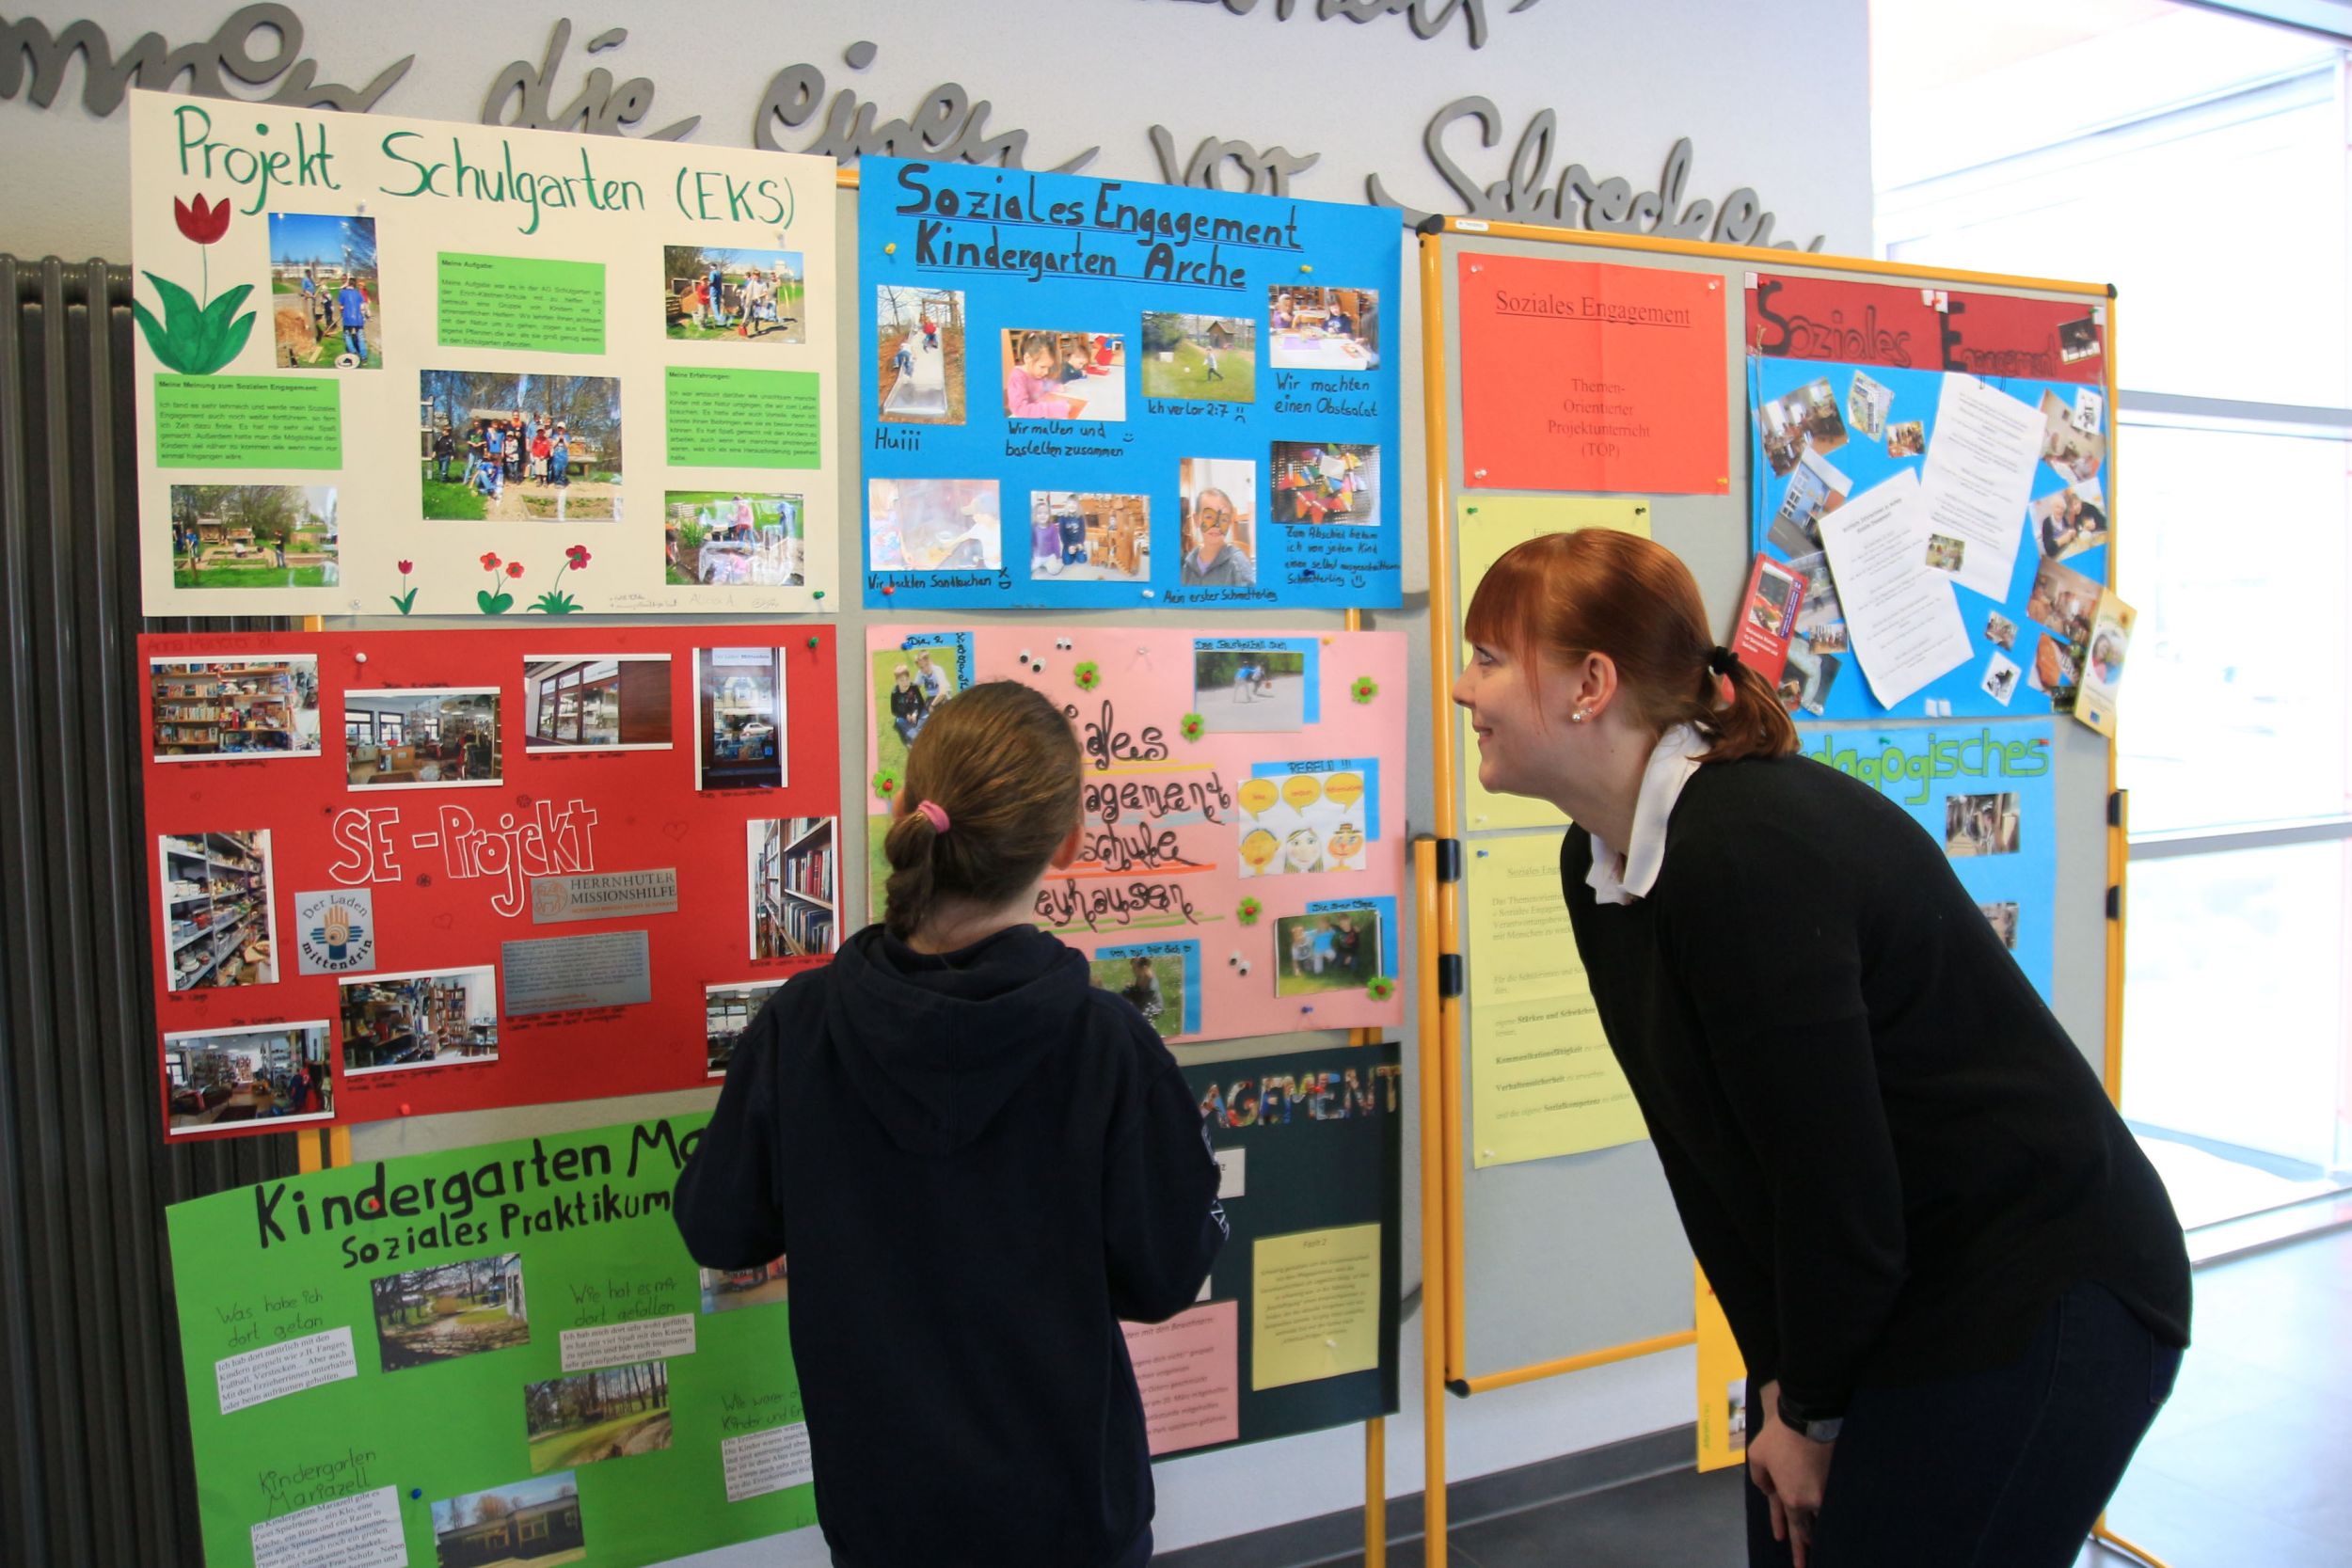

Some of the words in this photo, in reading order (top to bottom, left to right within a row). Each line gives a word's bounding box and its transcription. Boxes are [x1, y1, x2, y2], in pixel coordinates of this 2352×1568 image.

[482, 17, 702, 142] die
[173, 104, 342, 216] Projekt
[379, 131, 645, 236] Schulgarten
[675, 166, 796, 230] (EKS)
[896, 162, 1085, 227] Soziales
[1093, 182, 1304, 248] Engagement
[915, 219, 1117, 283] Kindergarten
[1144, 243, 1247, 287] Arche
[1495, 290, 1574, 315] Soziales
[1581, 296, 1692, 325] Engagement
[1757, 280, 1912, 368] Soziales
[1276, 372, 1300, 390] Wir
[1311, 374, 1371, 393] machten
[1571, 378, 1626, 394] Themen-
[1148, 403, 1167, 415] Ich
[1274, 395, 1311, 414] einen
[1316, 398, 1379, 418] Obstsalat
[1563, 399, 1634, 416] Orientierter
[1009, 422, 1026, 435] Wir
[1027, 421, 1073, 436] malten
[1080, 422, 1105, 437] und
[1548, 420, 1650, 438] Projektunterricht
[1065, 444, 1123, 457] zusammen
[1581, 442, 1621, 459] (TOP)
[1800, 727, 2050, 805] dagogisches
[1083, 771, 1232, 826] agement
[571, 872, 675, 890] HERRNHUTER
[571, 885, 677, 905] MISSIONSHILFE
[302, 899, 326, 920] Der
[330, 894, 368, 918] Laden
[302, 940, 373, 971] mittendrin
[1200, 1064, 1402, 1129] AGEMENT
[255, 1138, 612, 1249] Kindergarten
[342, 1212, 488, 1269] Soziales
[501, 1182, 672, 1240] Praktikum
[215, 1302, 253, 1325] Was
[264, 1295, 298, 1313] habe
[302, 1288, 324, 1305] ich
[569, 1283, 602, 1306] Wie
[609, 1279, 631, 1300] hat
[574, 1307, 608, 1327] dort
[617, 1296, 675, 1323] gefallen
[229, 1322, 261, 1349] dort
[274, 1312, 324, 1339] getan
[259, 1447, 377, 1494] Kindergarten
[268, 1466, 371, 1518] Mariazell
